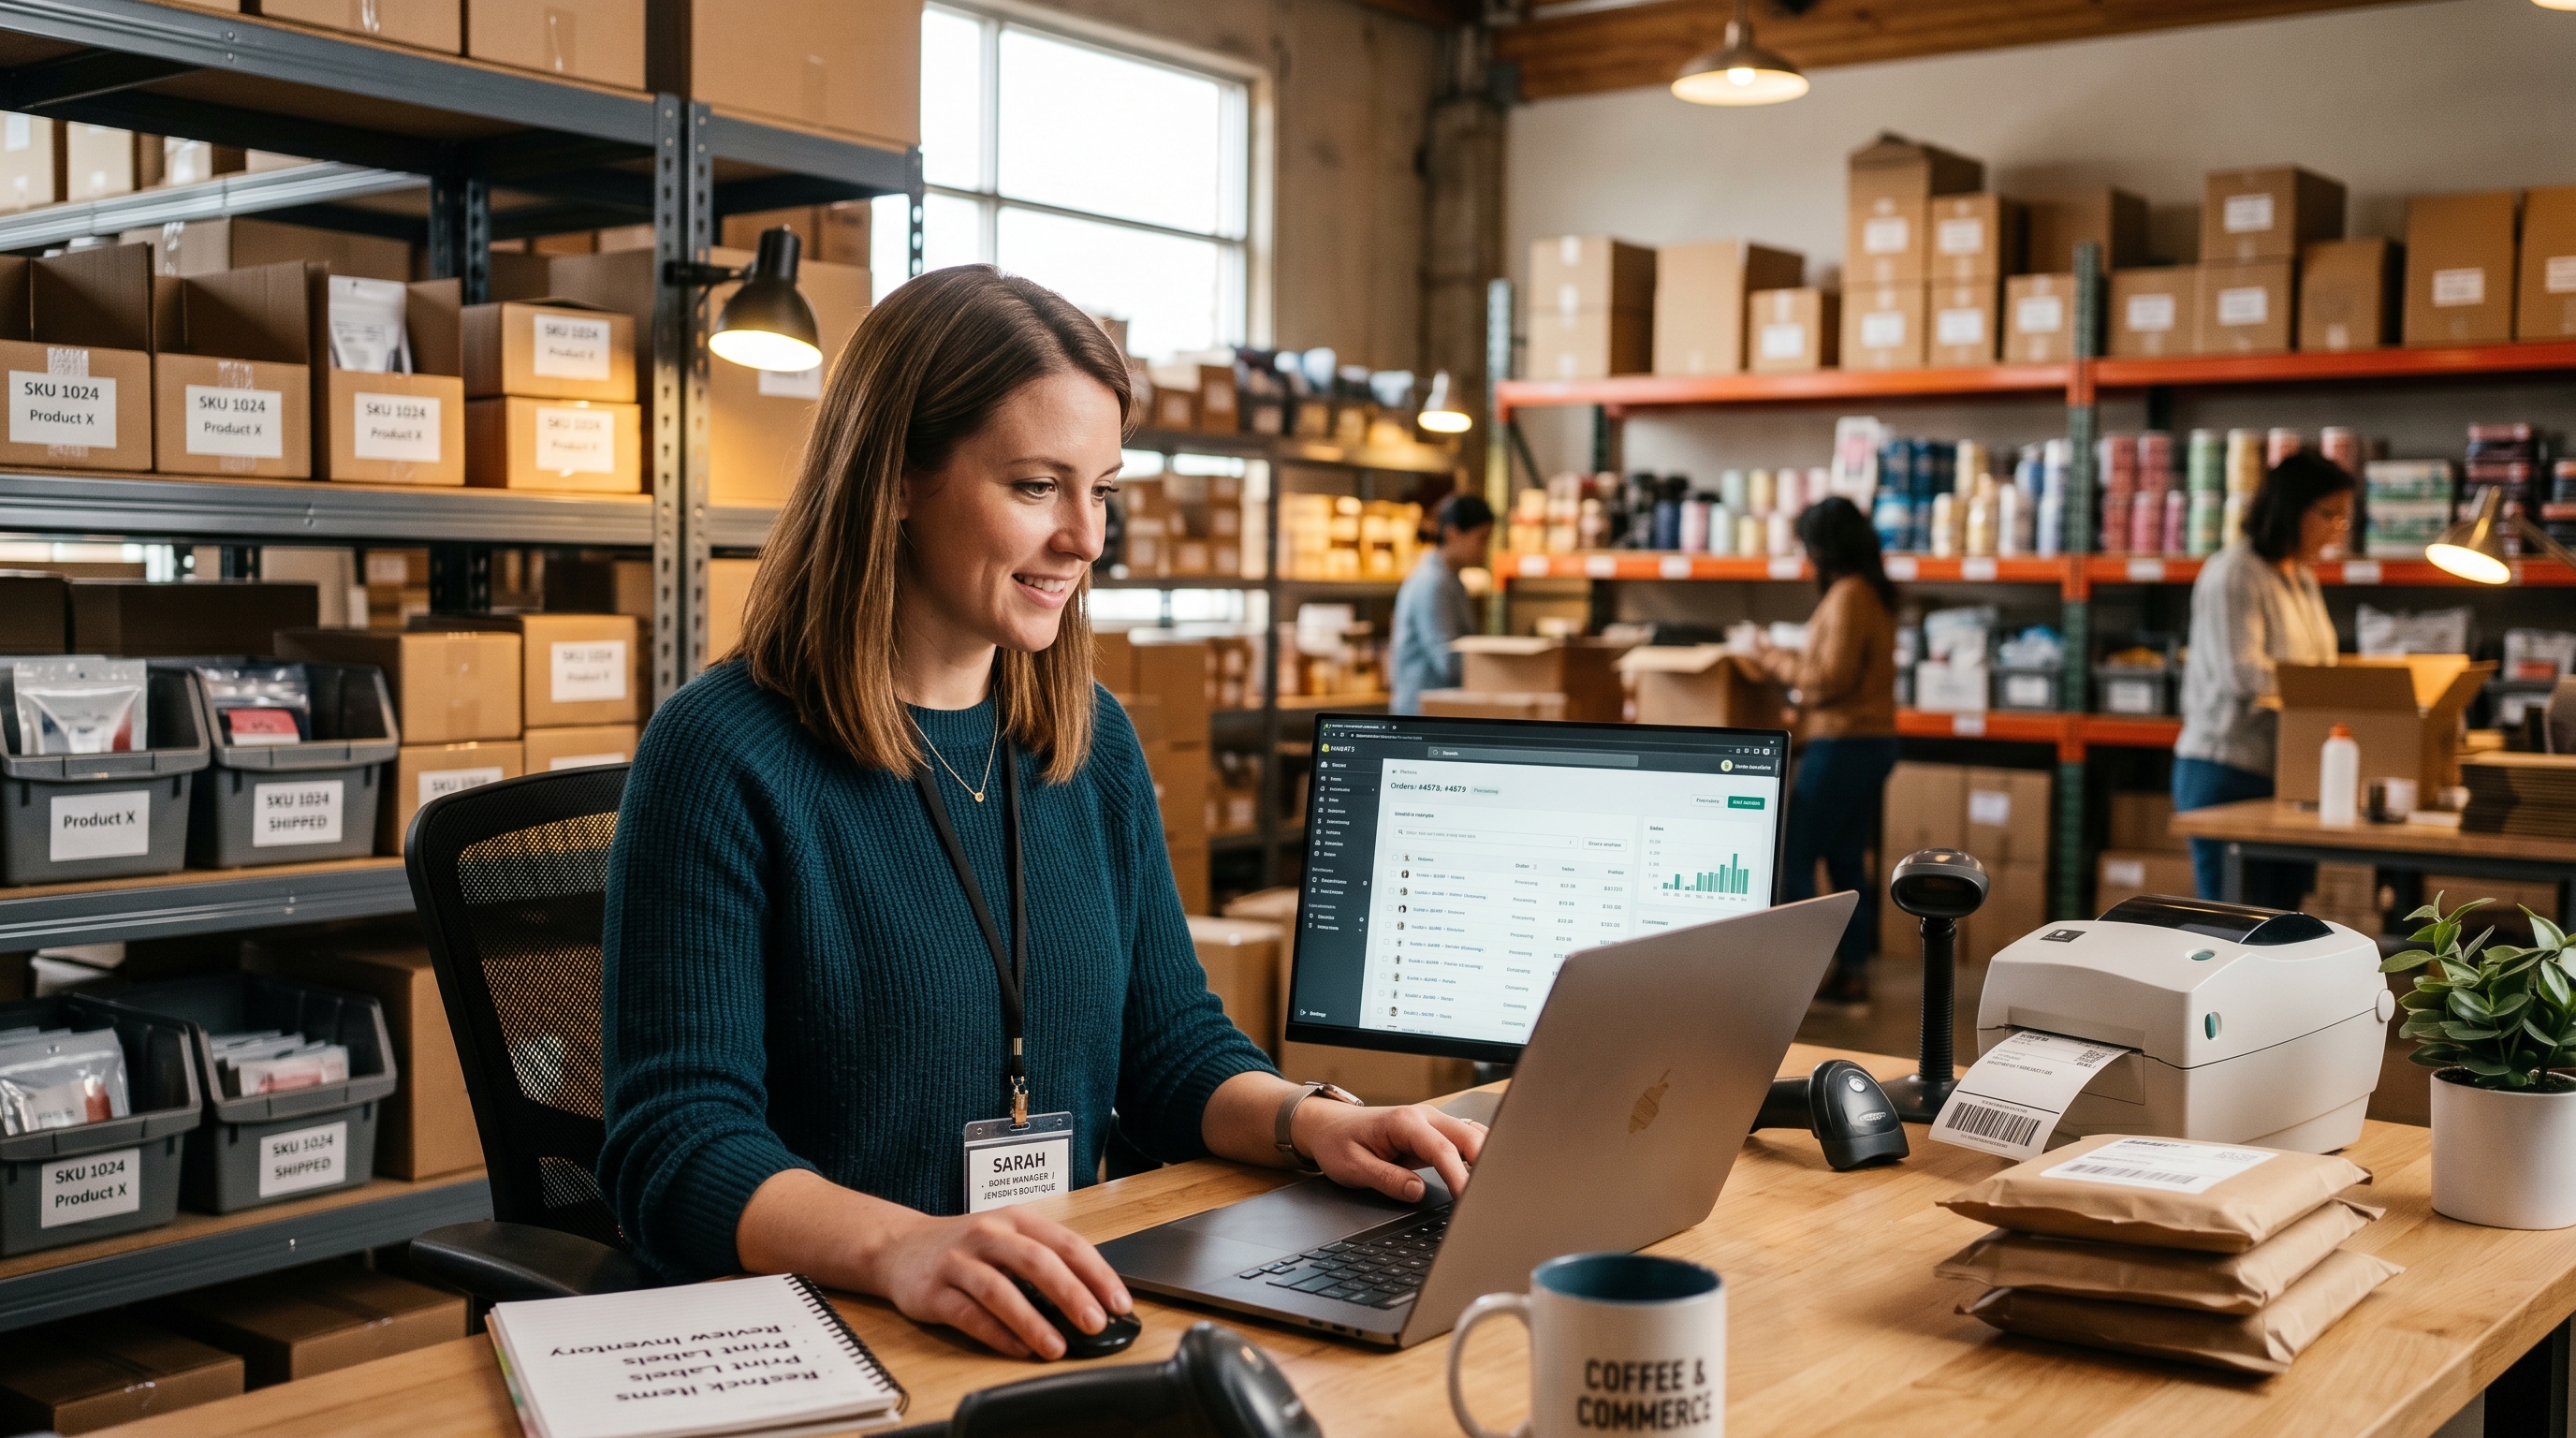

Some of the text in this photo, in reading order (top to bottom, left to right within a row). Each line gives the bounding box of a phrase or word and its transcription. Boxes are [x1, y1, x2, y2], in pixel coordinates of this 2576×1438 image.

[24, 381, 99, 401] SKU 1024
[199, 395, 266, 413] SKU 1024
[366, 402, 391, 417] SKU
[30, 409, 95, 425] Product X
[204, 421, 262, 436] Product X
[267, 792, 294, 809] SKU
[64, 810, 135, 829] Product X
[272, 1140, 299, 1157] SKU
[55, 1159, 124, 1184] SKU 1024
[274, 1155, 331, 1180] SHIPPED
[993, 1152, 1046, 1173] SARAH
[55, 1181, 126, 1208] Product X
[1018, 1182, 1056, 1196] BOUTIQUE
[550, 1324, 783, 1357] Review Inventory
[622, 1339, 791, 1365] Print Labels
[629, 1354, 801, 1382] Print Labels
[1584, 1357, 1706, 1393] COFFEE &
[1576, 1390, 1713, 1431] COMMERCE
